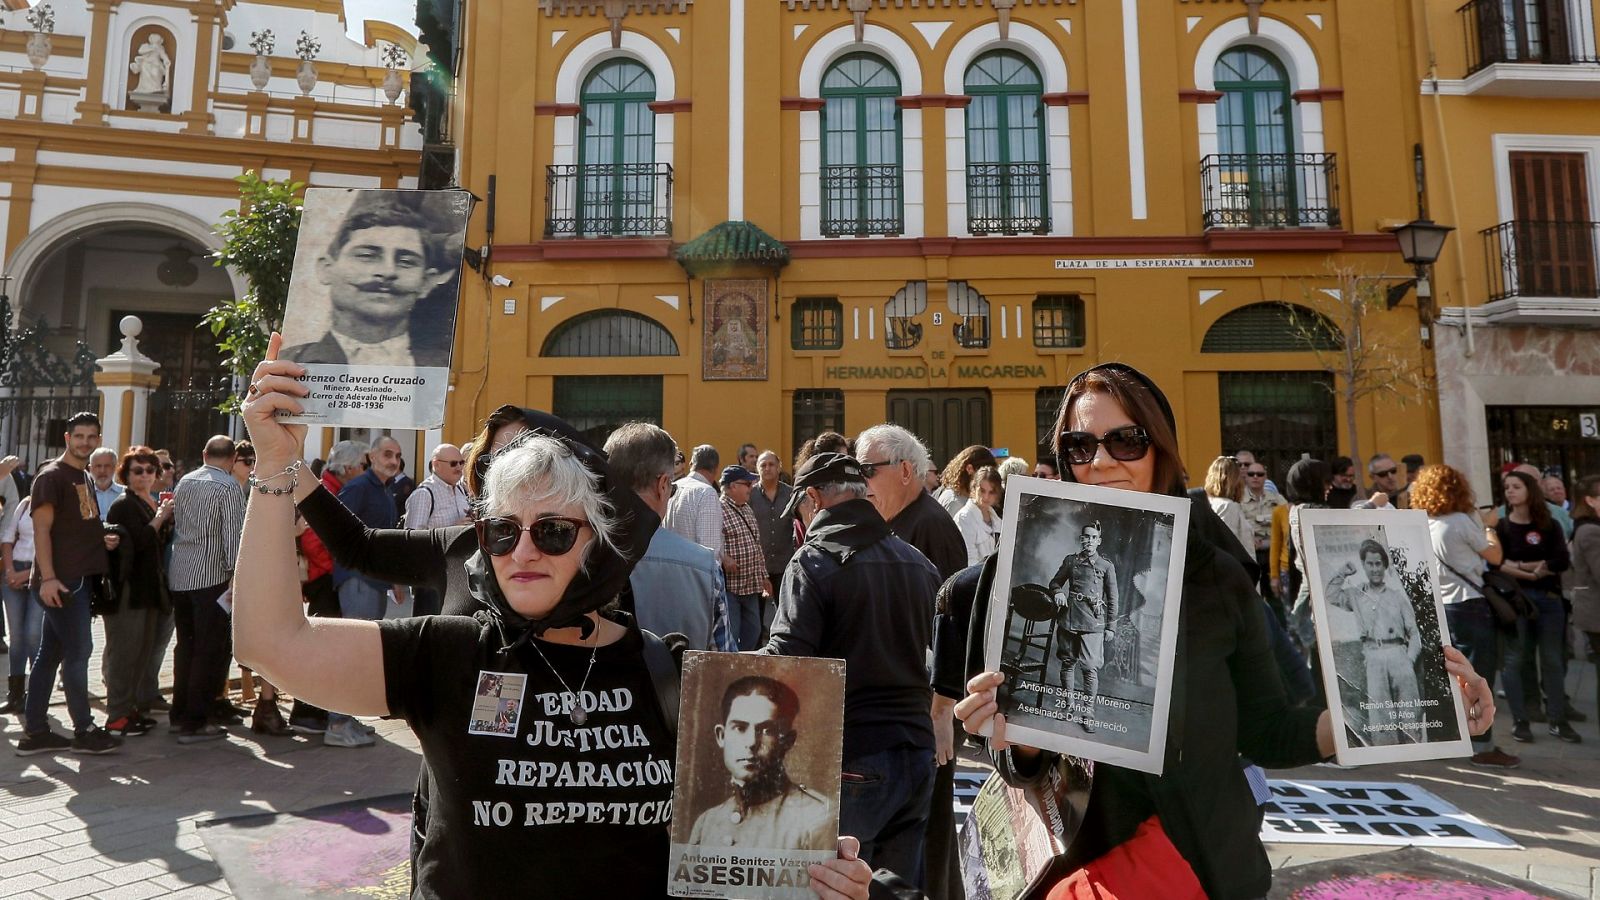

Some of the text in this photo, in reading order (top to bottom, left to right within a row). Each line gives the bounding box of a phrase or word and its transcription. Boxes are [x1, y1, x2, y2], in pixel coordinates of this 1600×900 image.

[1056, 258, 1254, 268] PLAZA DE LA ESPERANZA MACARENA
[934, 312, 942, 324] 3
[931, 350, 945, 360] DE
[826, 366, 926, 379] HERMANDAD
[930, 367, 946, 378] LA
[957, 365, 1047, 379] MACARENA
[338, 374, 379, 385] Clavero
[382, 375, 426, 386] Cruzado
[323, 384, 352, 392] Minero.
[312, 392, 333, 400] Cerro
[335, 393, 345, 401] de
[379, 394, 411, 403] (Huelva)
[327, 400, 384, 410] el 28-08-1936
[1583, 416, 1596, 437] 3
[1020, 680, 1131, 710] Antonio Sánchez Moreno
[535, 688, 634, 717] ERDAD
[1054, 699, 1092, 714] 26 Años
[1385, 699, 1413, 709] Sánchez
[1414, 698, 1439, 707] Moreno
[1017, 703, 1128, 734] Asesinado-Desaparecido
[1388, 711, 1416, 720] 19 Años
[1363, 720, 1443, 732] Asesinado-Desaparecido
[526, 720, 651, 752] JUSTICIA
[495, 754, 673, 788] REPARACIÓN
[472, 791, 673, 827] NO REPETICIÓ
[1260, 819, 1477, 838] FUER
[681, 853, 727, 865] Antonio
[672, 863, 811, 888] ASESINAD
